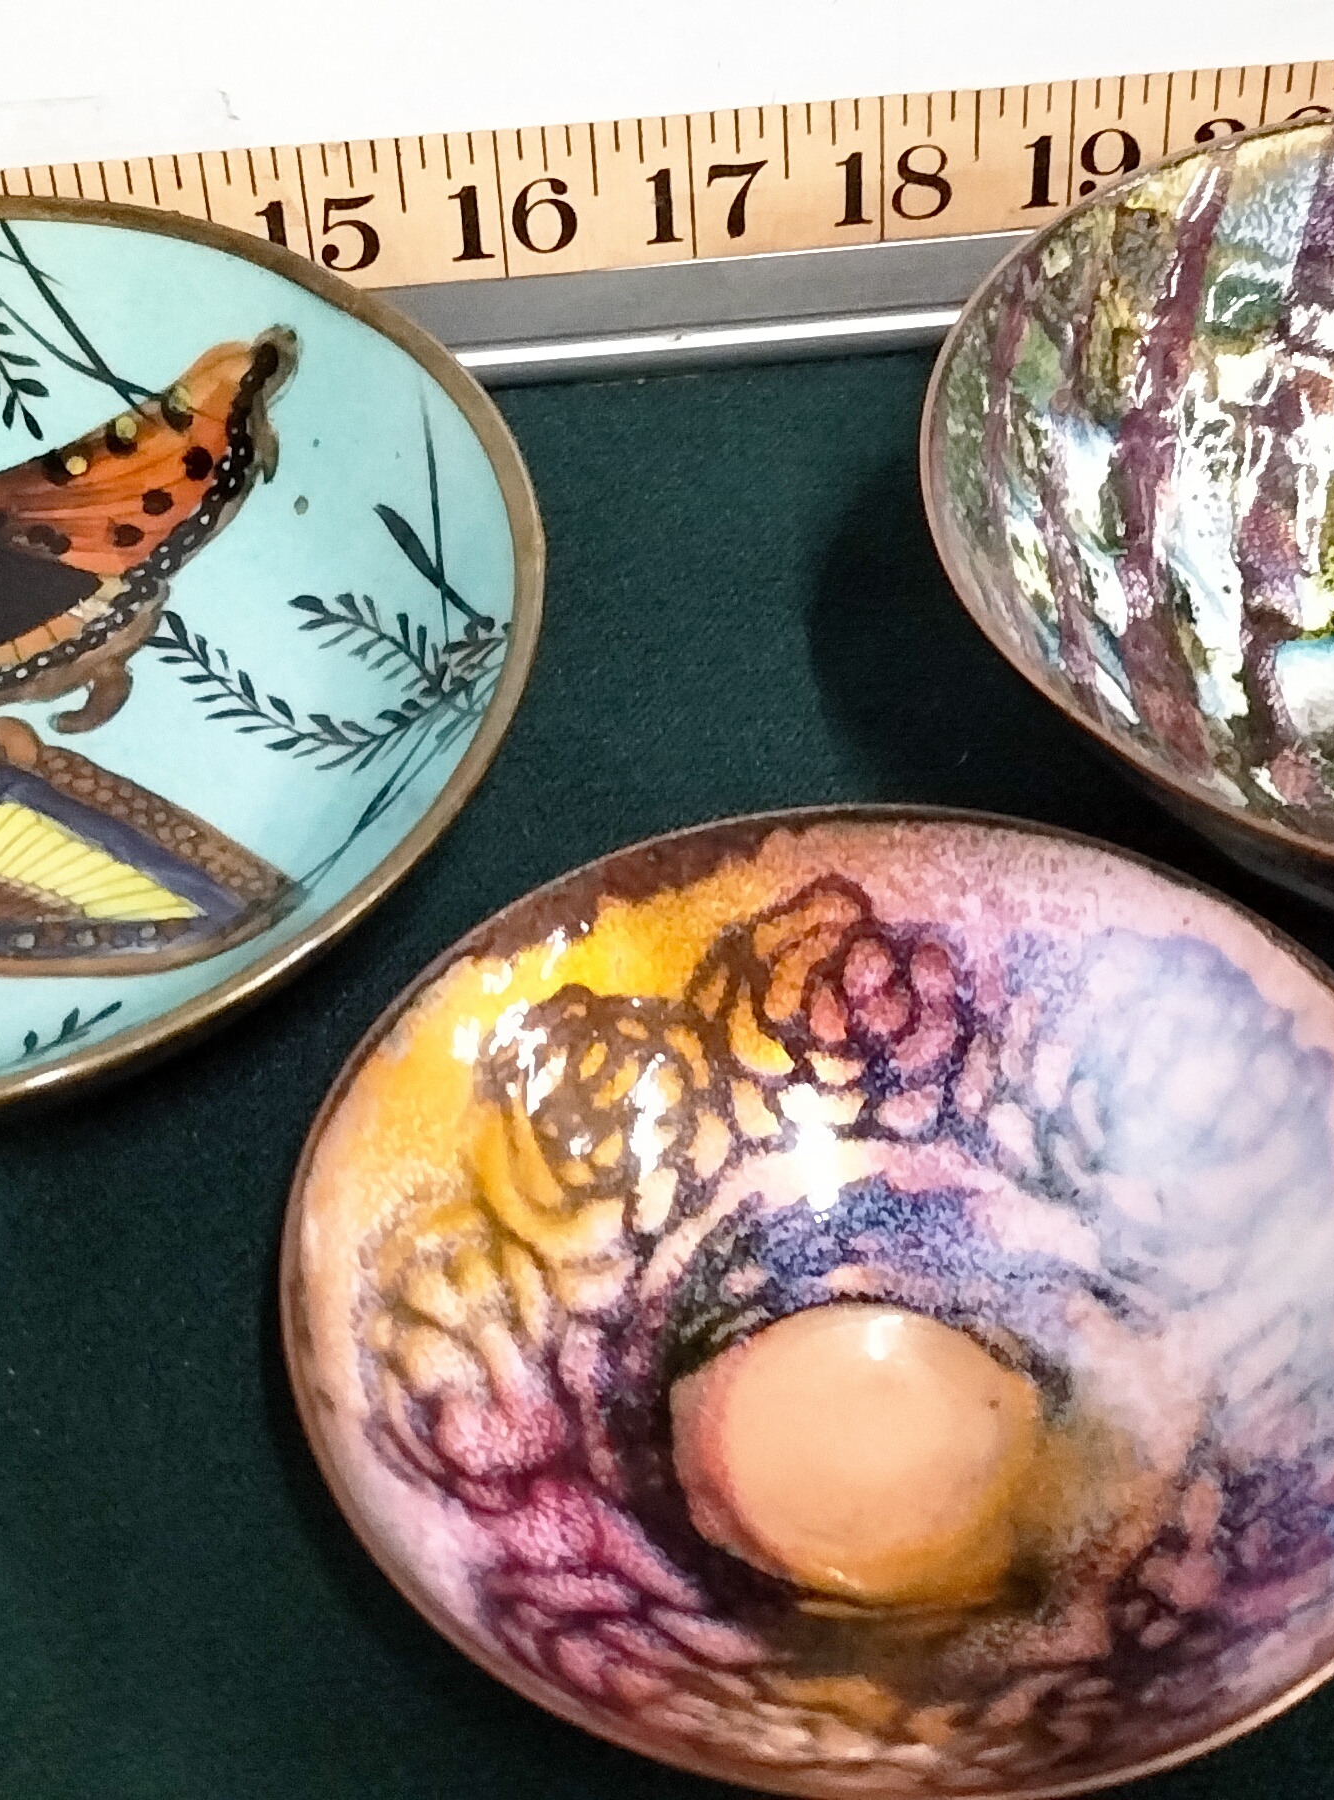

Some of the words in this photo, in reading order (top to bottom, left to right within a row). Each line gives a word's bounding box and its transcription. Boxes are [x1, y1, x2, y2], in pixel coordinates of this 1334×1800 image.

[256, 194, 380, 271] 15
[448, 178, 578, 262] 16
[646, 160, 768, 246] 17
[835, 144, 952, 227] 18
[1021, 128, 1142, 210] 19
